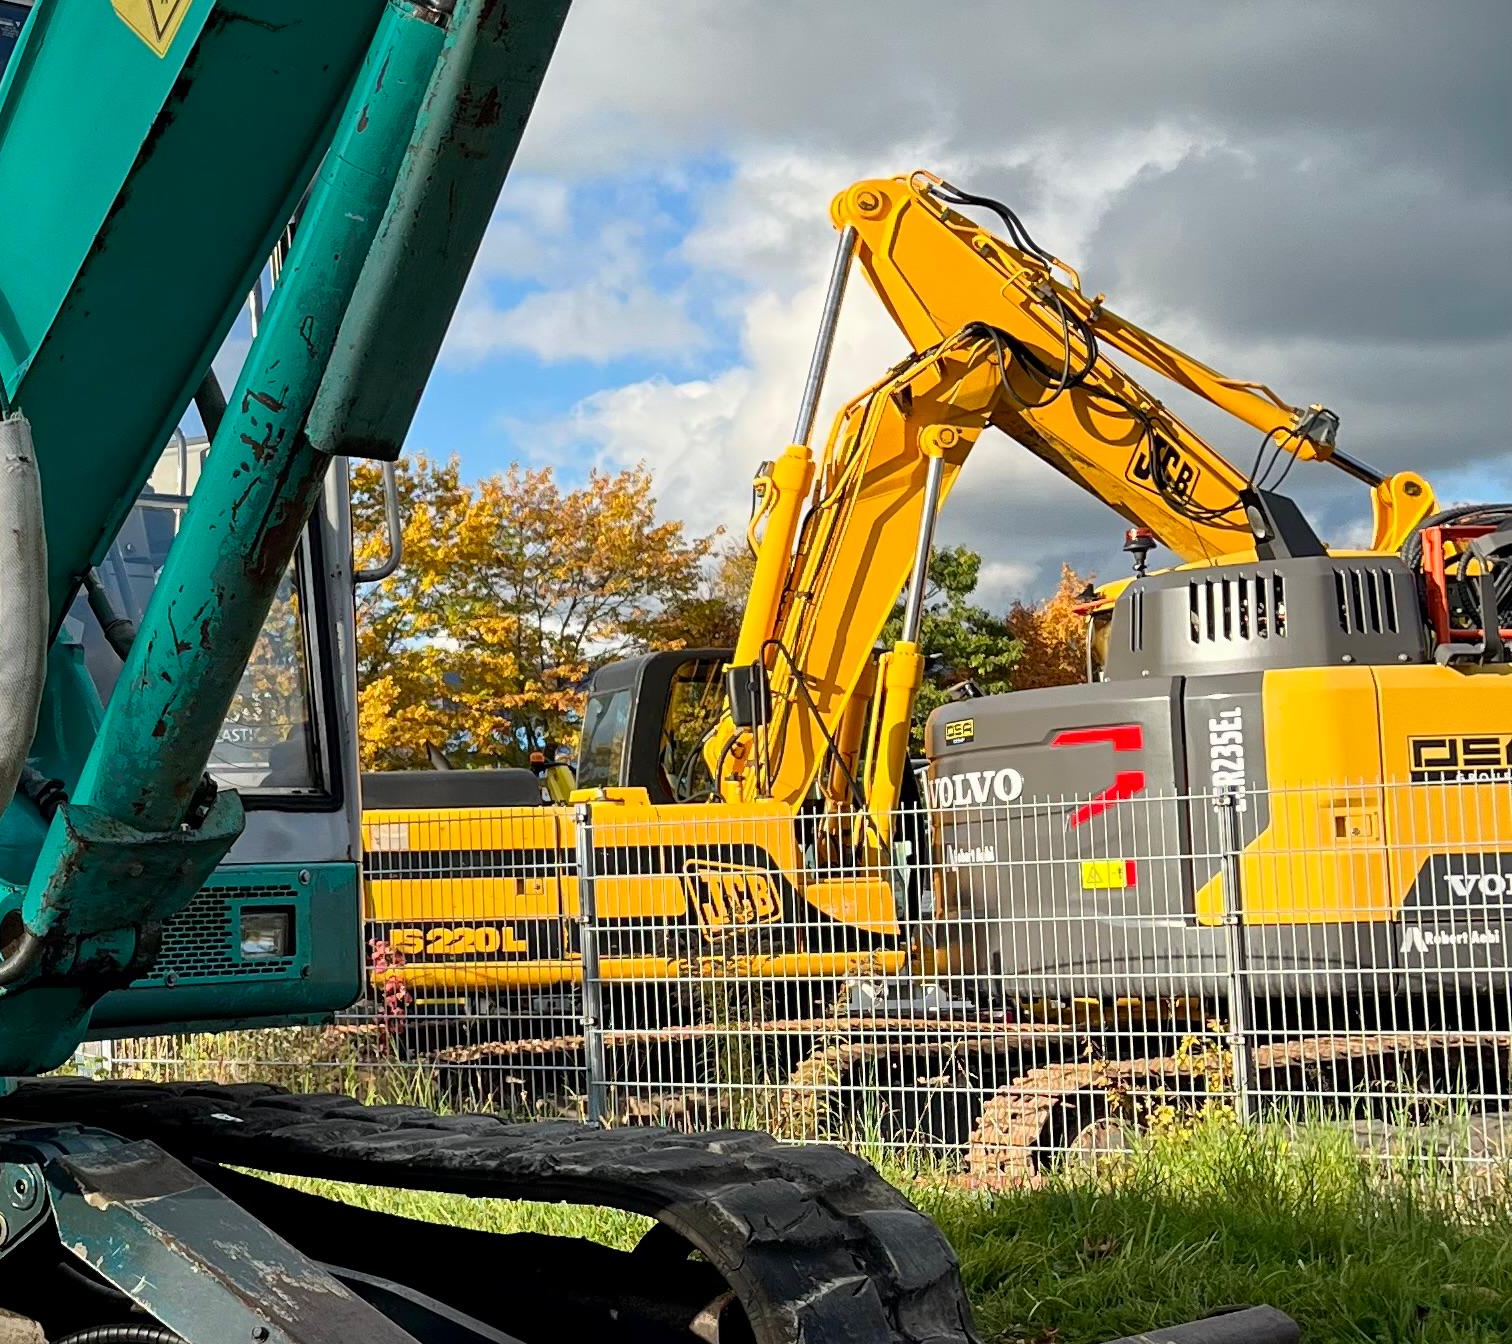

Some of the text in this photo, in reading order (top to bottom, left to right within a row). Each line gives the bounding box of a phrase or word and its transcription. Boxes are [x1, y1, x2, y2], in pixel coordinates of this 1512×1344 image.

[928, 768, 1024, 809] VOLVO
[698, 869, 775, 933] JCB
[1443, 872, 1512, 896] VO
